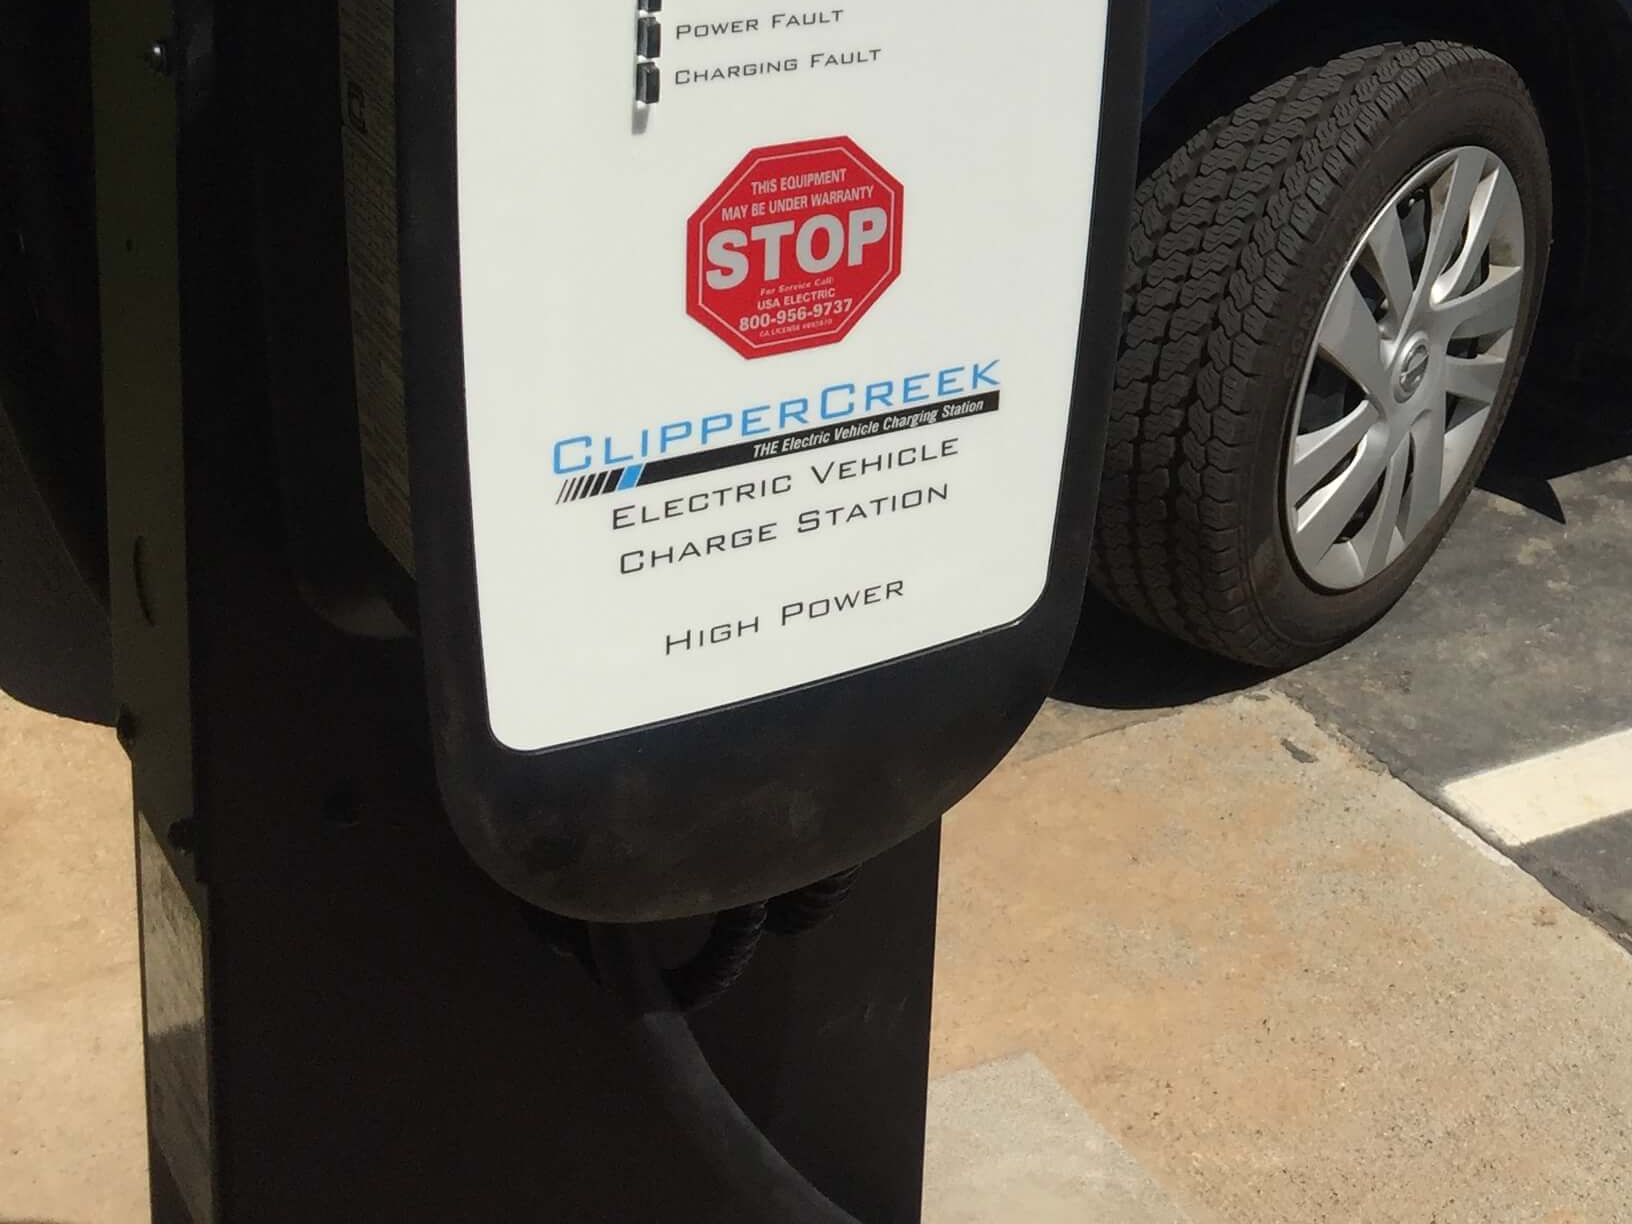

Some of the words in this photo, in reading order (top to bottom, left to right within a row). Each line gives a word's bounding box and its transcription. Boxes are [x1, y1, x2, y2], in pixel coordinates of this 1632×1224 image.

[676, 17, 760, 39] POWER
[772, 8, 844, 28] FAULT
[675, 58, 799, 85] CHARGING
[810, 48, 881, 69] FAULT
[722, 205, 748, 221] MAY
[751, 202, 765, 217] BE
[769, 196, 808, 214] UNDER
[811, 186, 874, 207] WARRANTY
[751, 179, 777, 195] THIS
[780, 168, 846, 190] EQUIPMENT
[706, 207, 887, 290] STOP
[739, 298, 853, 332] 800-956-9737
[757, 299, 781, 310] USA
[783, 288, 836, 306] ELECTRIC
[552, 359, 1000, 475] CLIPPERCREEK
[753, 440, 779, 458] THE
[781, 430, 830, 454] Electric
[832, 417, 880, 444] Vehicle
[882, 409, 938, 433] Charging
[942, 398, 984, 420] Station
[613, 474, 792, 529] ELECTRIC
[810, 437, 958, 484] VEHICLE
[620, 523, 777, 575] CHARGE
[797, 483, 949, 533] STATION
[665, 616, 760, 655] HIGH
[781, 579, 904, 626] POWER
